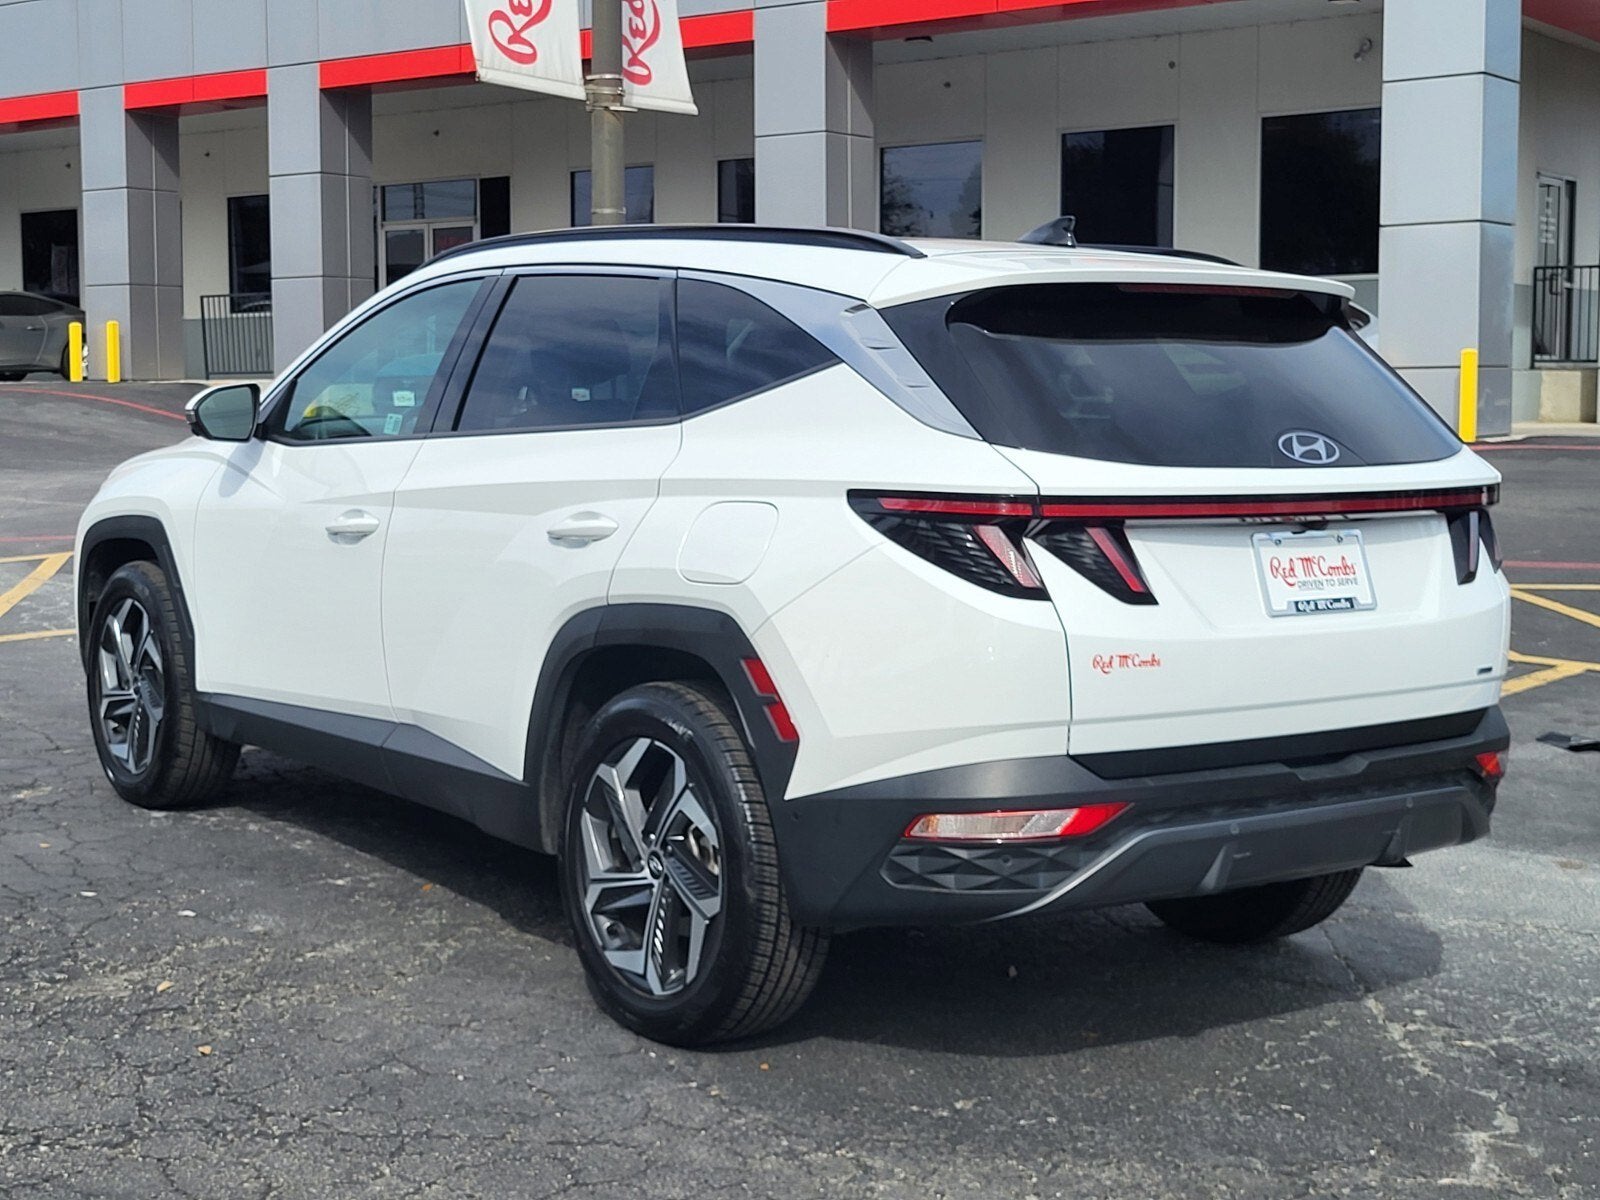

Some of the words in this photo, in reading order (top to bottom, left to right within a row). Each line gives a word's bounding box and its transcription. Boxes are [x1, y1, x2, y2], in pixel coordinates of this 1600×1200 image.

[488, 0, 551, 65] Re
[1270, 557, 1296, 587] Red
[1297, 555, 1356, 577] McCombs
[1297, 579, 1324, 588] DRIVEN
[1325, 578, 1336, 587] TO
[1337, 577, 1359, 587] SERVE
[1093, 654, 1114, 674] Red
